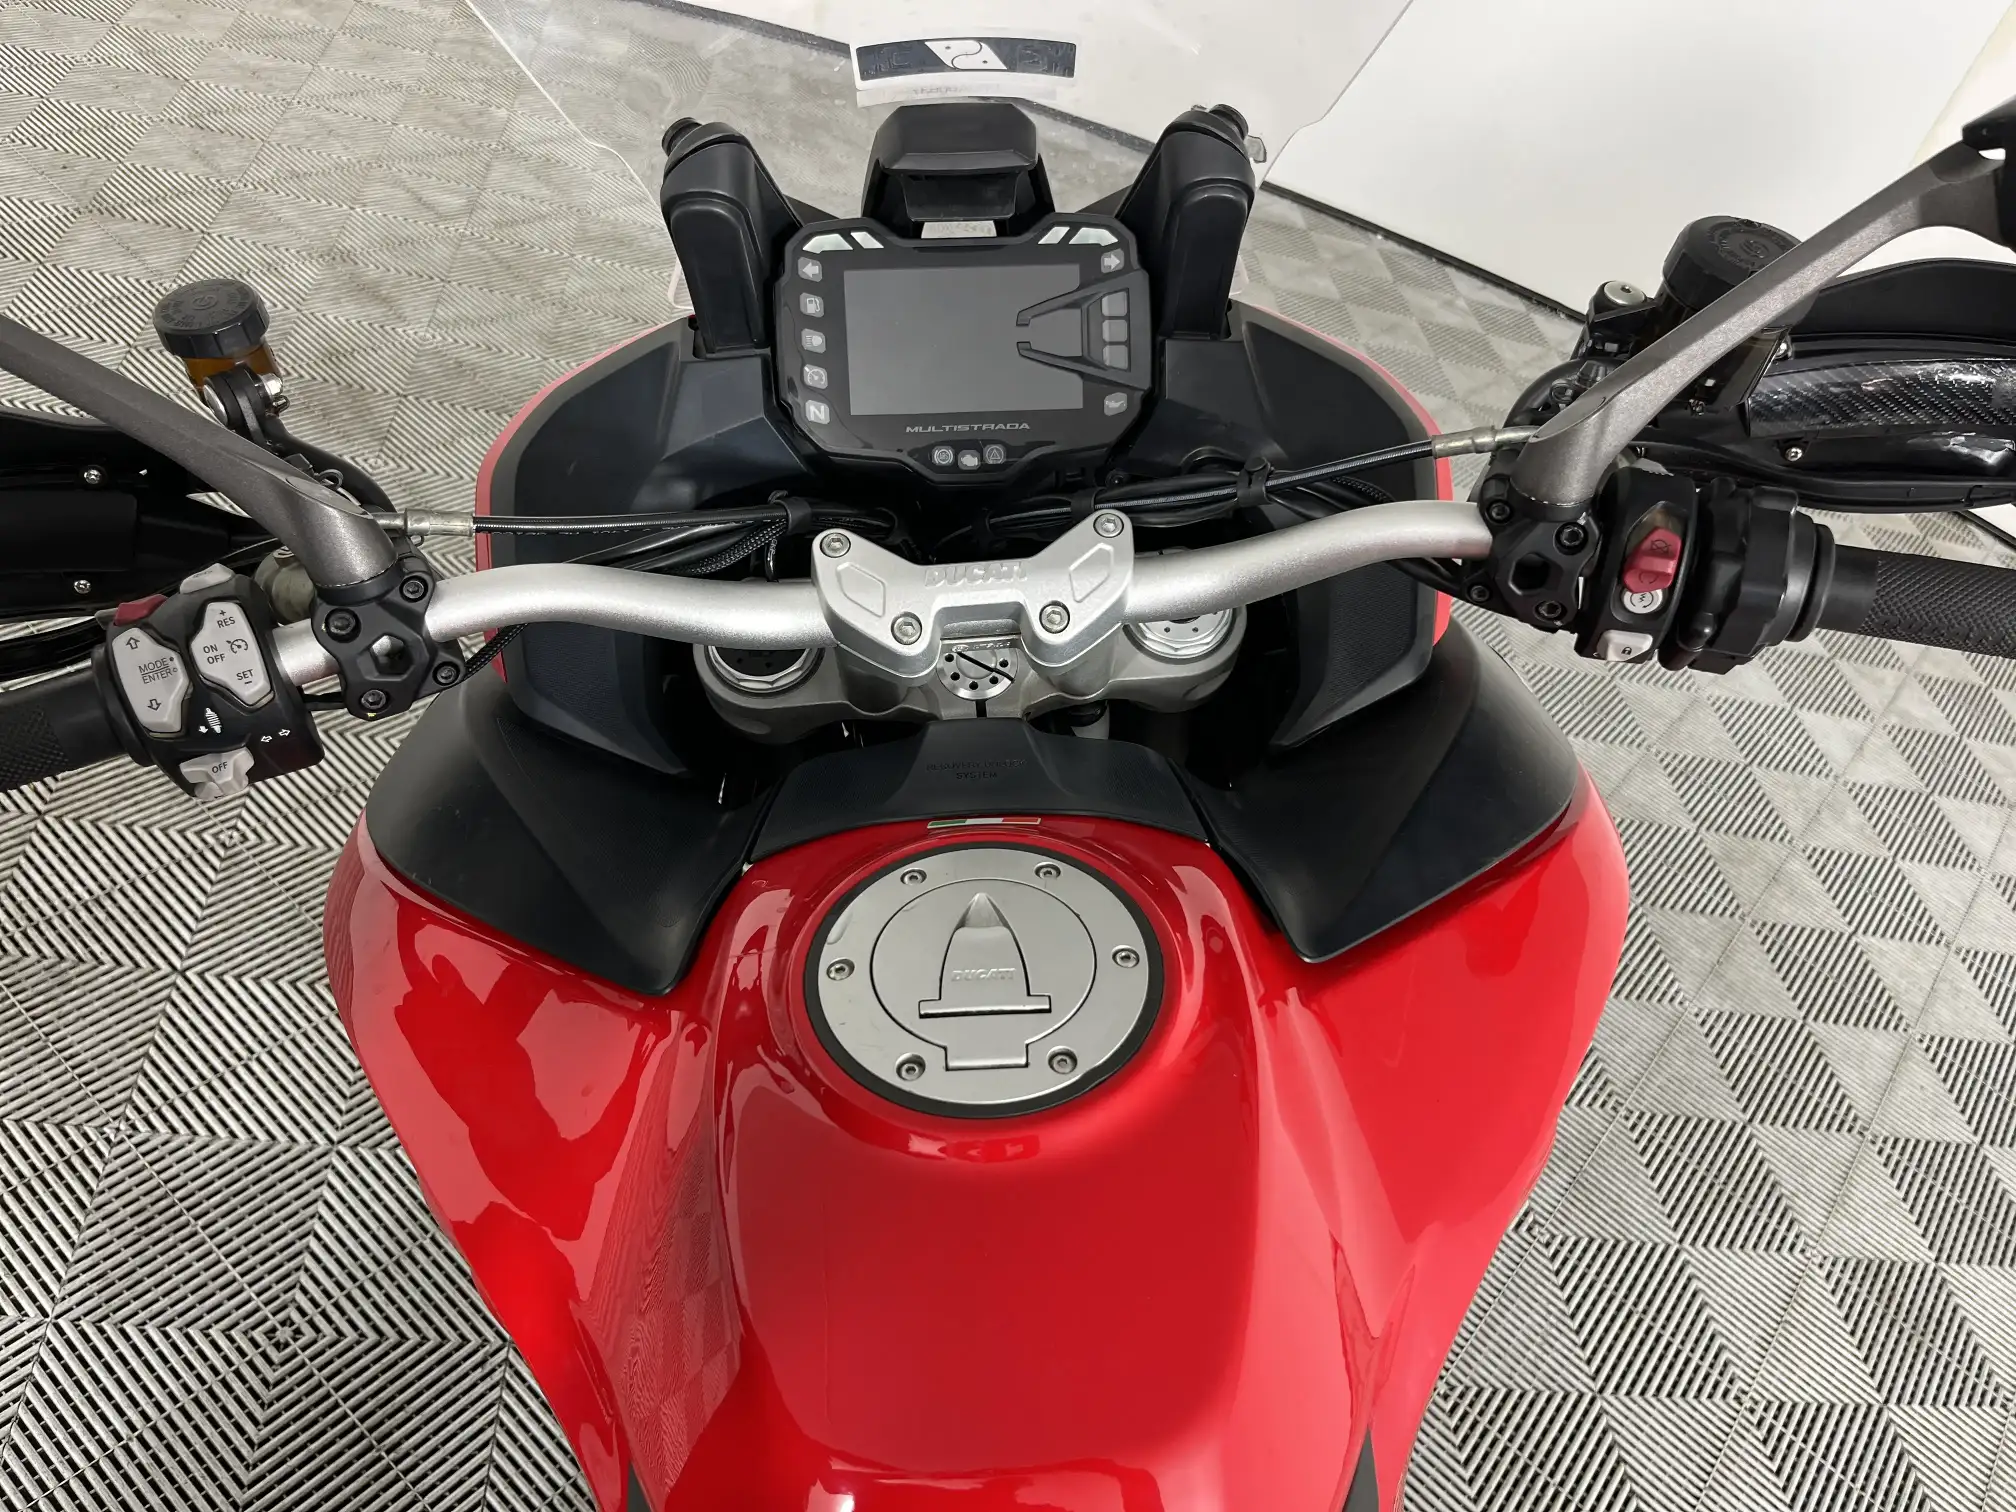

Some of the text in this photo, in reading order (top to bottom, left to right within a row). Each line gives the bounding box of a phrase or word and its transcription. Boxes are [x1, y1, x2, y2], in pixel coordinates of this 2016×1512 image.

[810, 405, 825, 421] N
[905, 422, 1030, 433] MULTISTRADA
[925, 562, 1028, 588] DUCATI
[217, 617, 236, 629] RES
[203, 644, 218, 654] ON
[207, 654, 226, 665] OFF
[138, 658, 168, 674] MODE
[142, 669, 172, 684] ENTER
[236, 669, 254, 681] SET
[211, 762, 228, 774] OFF
[956, 772, 998, 780] SYSTEM
[951, 967, 1016, 982] DUCATI
